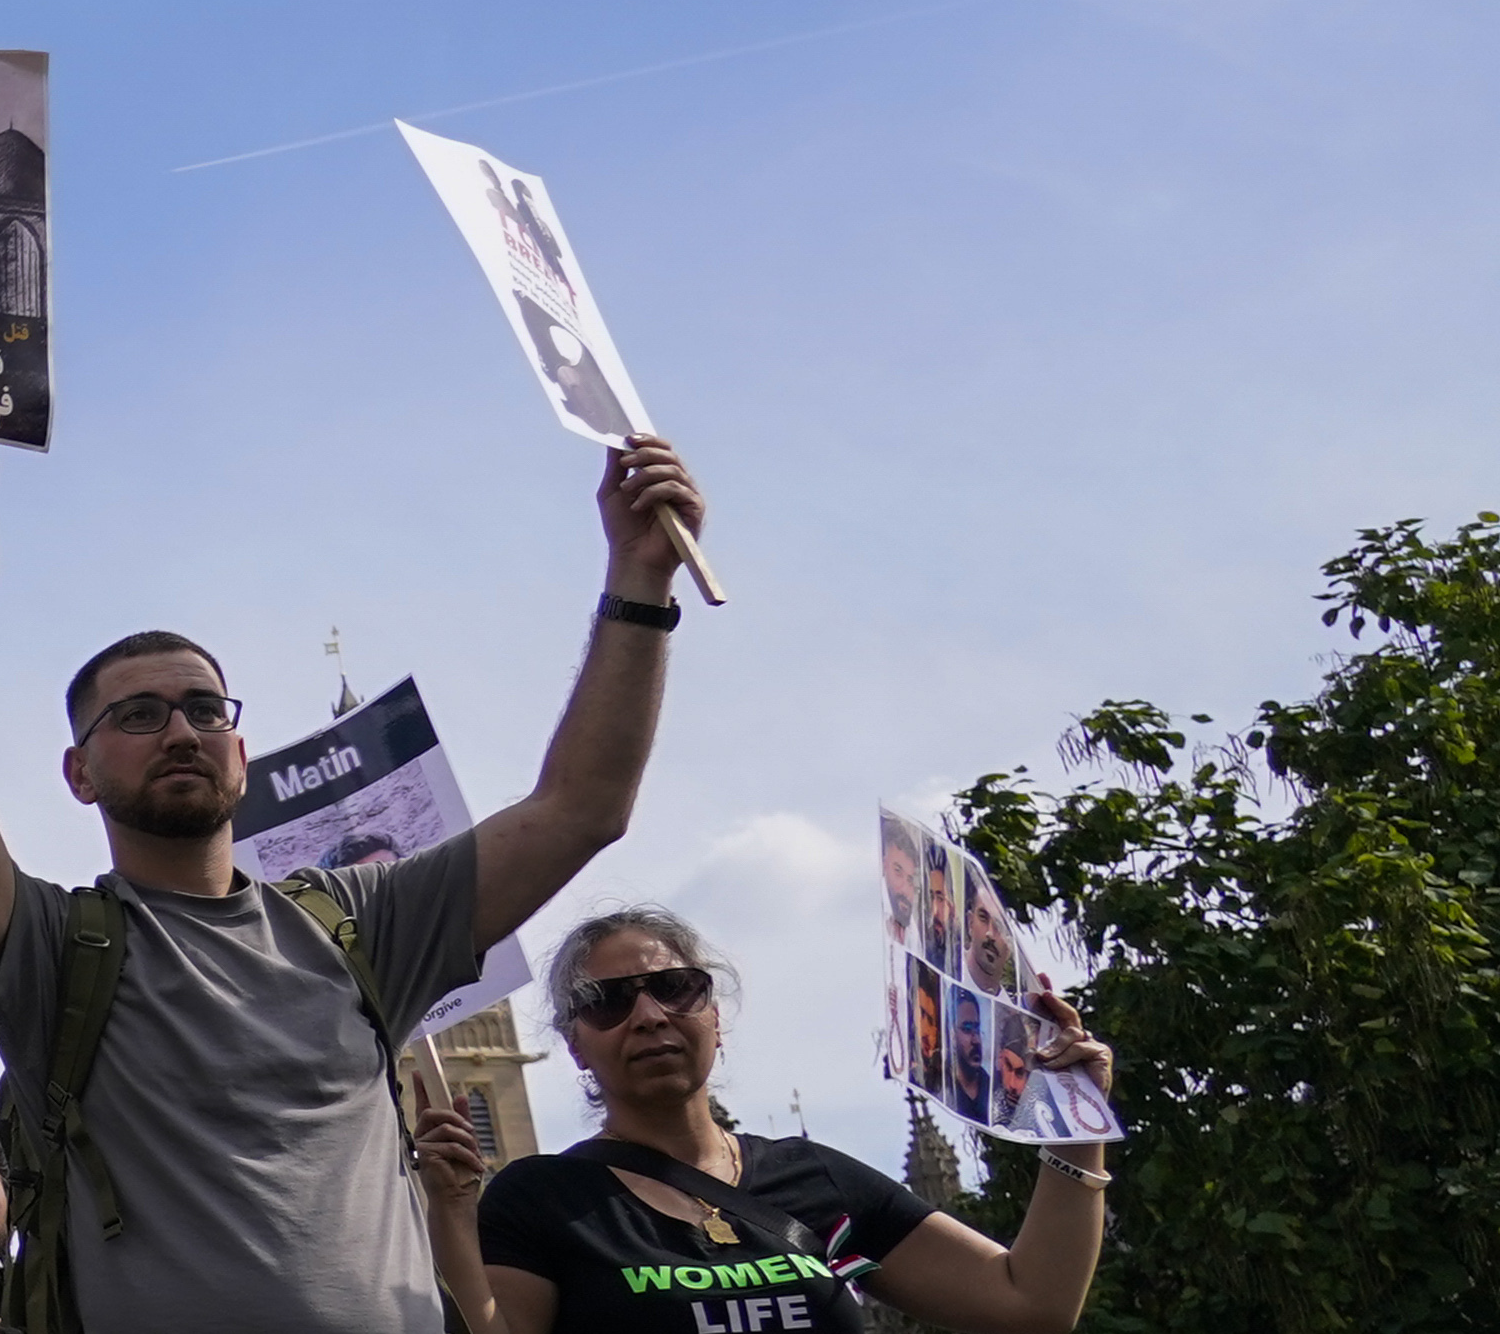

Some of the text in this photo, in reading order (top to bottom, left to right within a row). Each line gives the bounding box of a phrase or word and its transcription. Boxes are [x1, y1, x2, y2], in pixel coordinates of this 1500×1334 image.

[3, 322, 31, 344] قتل
[269, 745, 363, 803] Matin
[422, 996, 463, 1023] orgive
[1047, 1153, 1085, 1180] IRAN
[621, 1253, 833, 1294] WOMEN
